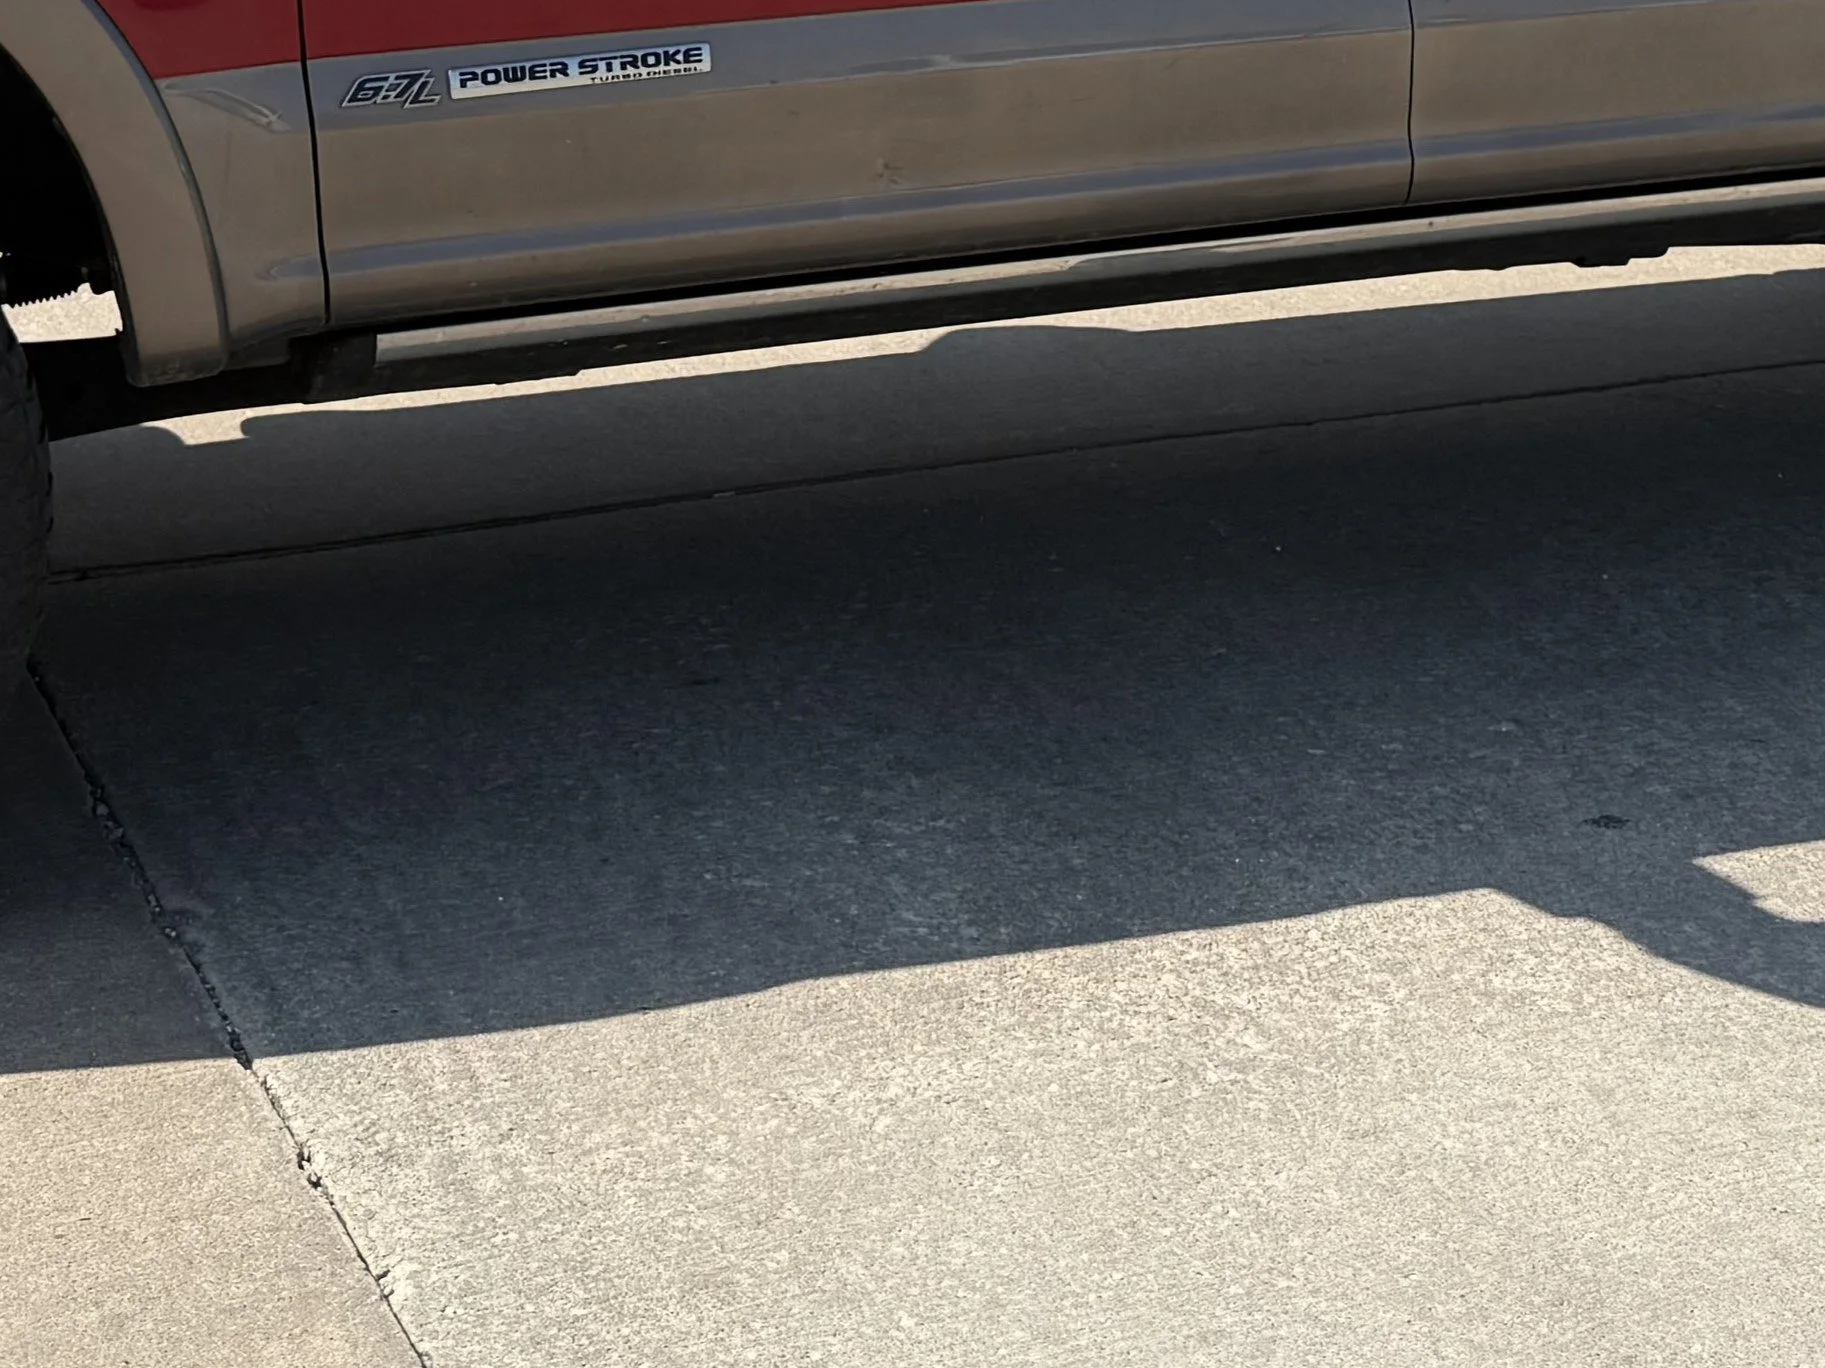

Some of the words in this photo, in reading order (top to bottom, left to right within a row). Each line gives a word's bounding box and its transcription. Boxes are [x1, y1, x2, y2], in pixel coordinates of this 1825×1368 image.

[342, 69, 442, 108] 6.7L
[458, 57, 570, 89] POWER
[577, 46, 704, 76] STROKE
